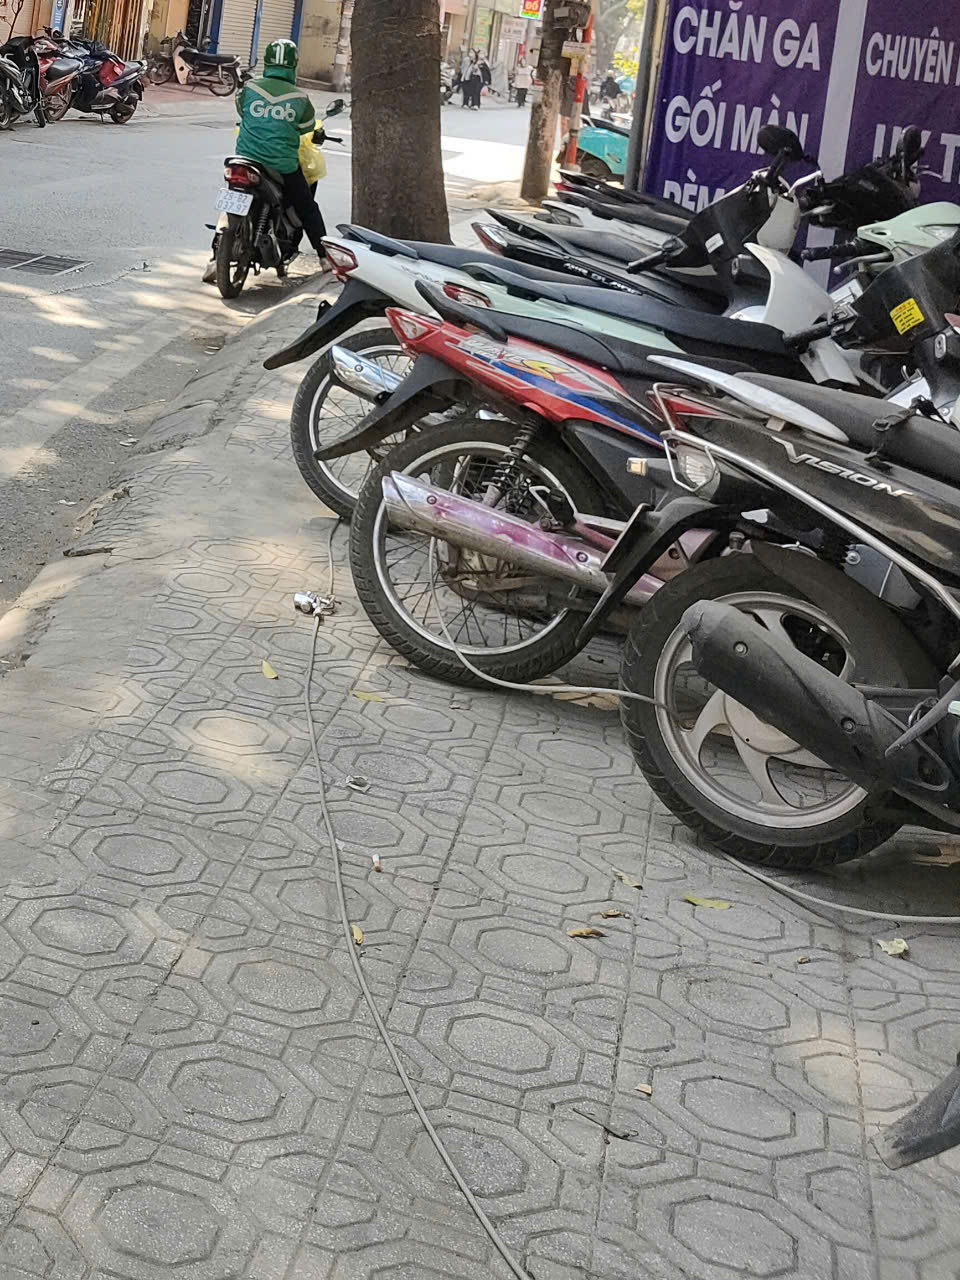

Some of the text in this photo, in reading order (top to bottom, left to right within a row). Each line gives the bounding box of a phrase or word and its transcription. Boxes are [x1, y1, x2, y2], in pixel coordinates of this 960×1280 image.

[673, 0, 820, 70] CHĂN GA
[866, 27, 953, 84] CHUYÊN
[249, 99, 297, 122] Grab
[665, 79, 727, 147] GỐI
[770, 435, 915, 498] VISION
